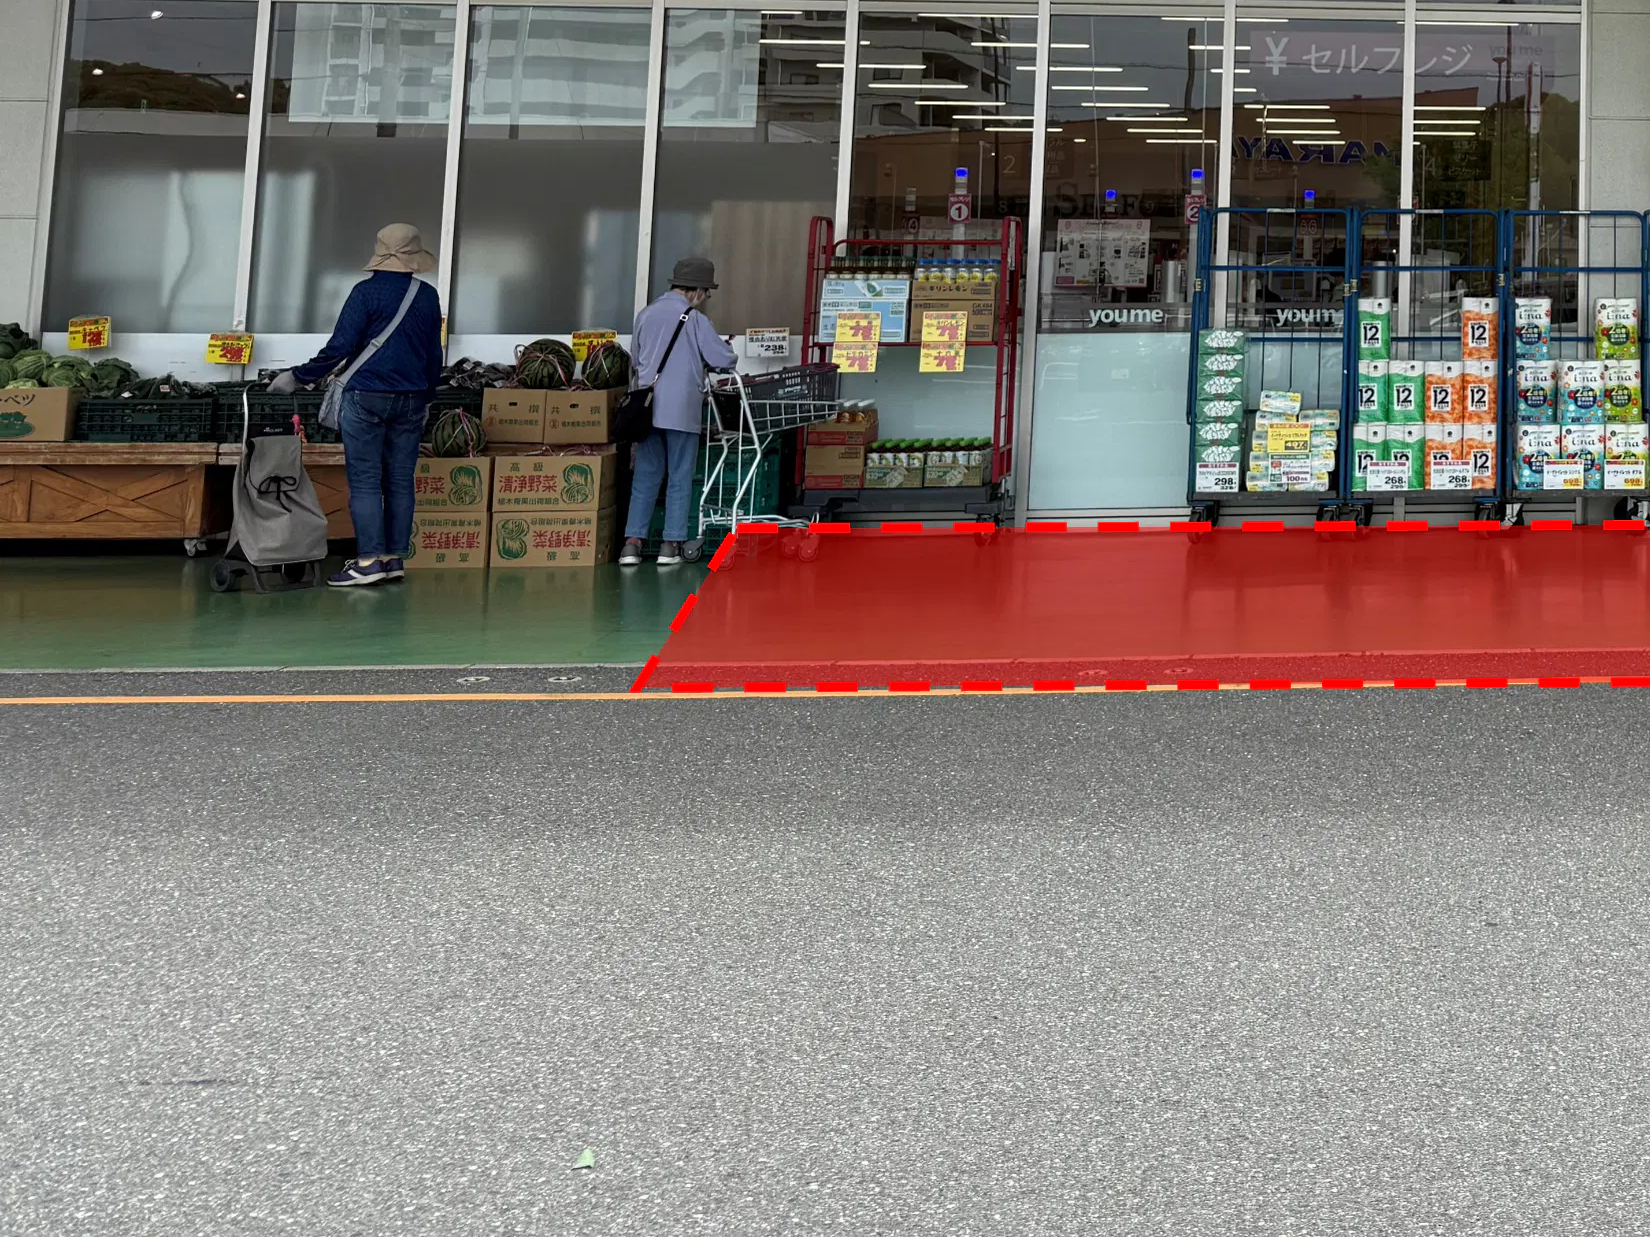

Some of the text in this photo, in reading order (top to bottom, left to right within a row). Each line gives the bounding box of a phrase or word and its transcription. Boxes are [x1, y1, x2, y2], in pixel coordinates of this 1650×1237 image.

[1088, 308, 1163, 327] youme
[1363, 325, 1380, 343] 12
[1471, 325, 1487, 343] 12
[0, 394, 36, 406] ベツ
[1359, 388, 1375, 405] 12
[1396, 388, 1412, 405] 12
[1433, 389, 1449, 407] 12
[1471, 389, 1487, 406] 12
[415, 477, 445, 494] 野菜
[1385, 476, 1403, 484] 268
[1449, 475, 1467, 483] 268
